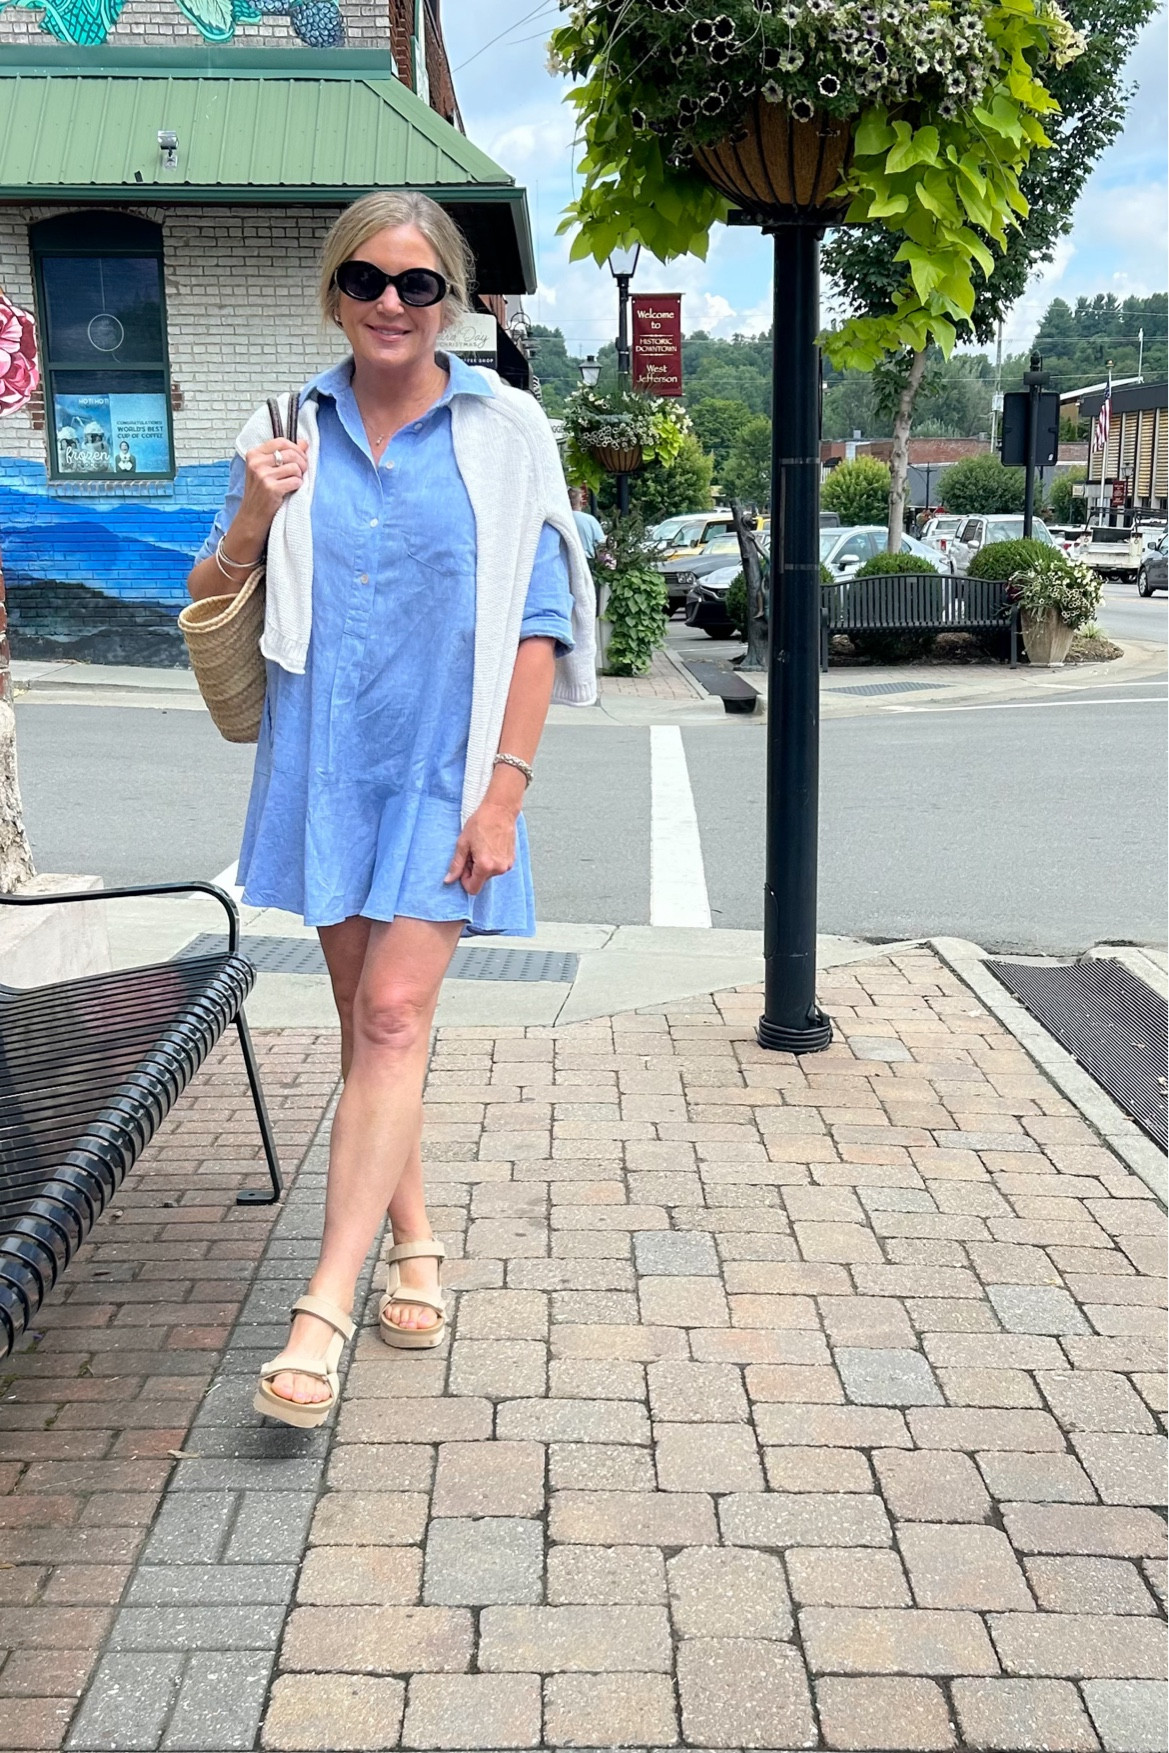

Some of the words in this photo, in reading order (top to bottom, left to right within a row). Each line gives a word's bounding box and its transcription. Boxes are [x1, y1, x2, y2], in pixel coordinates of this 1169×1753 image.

[637, 308, 674, 318] Welcome
[650, 321, 661, 329] to
[459, 325, 489, 349] Day
[646, 364, 668, 373] West
[637, 372, 678, 383] Jefferson
[66, 445, 111, 465] frozen
